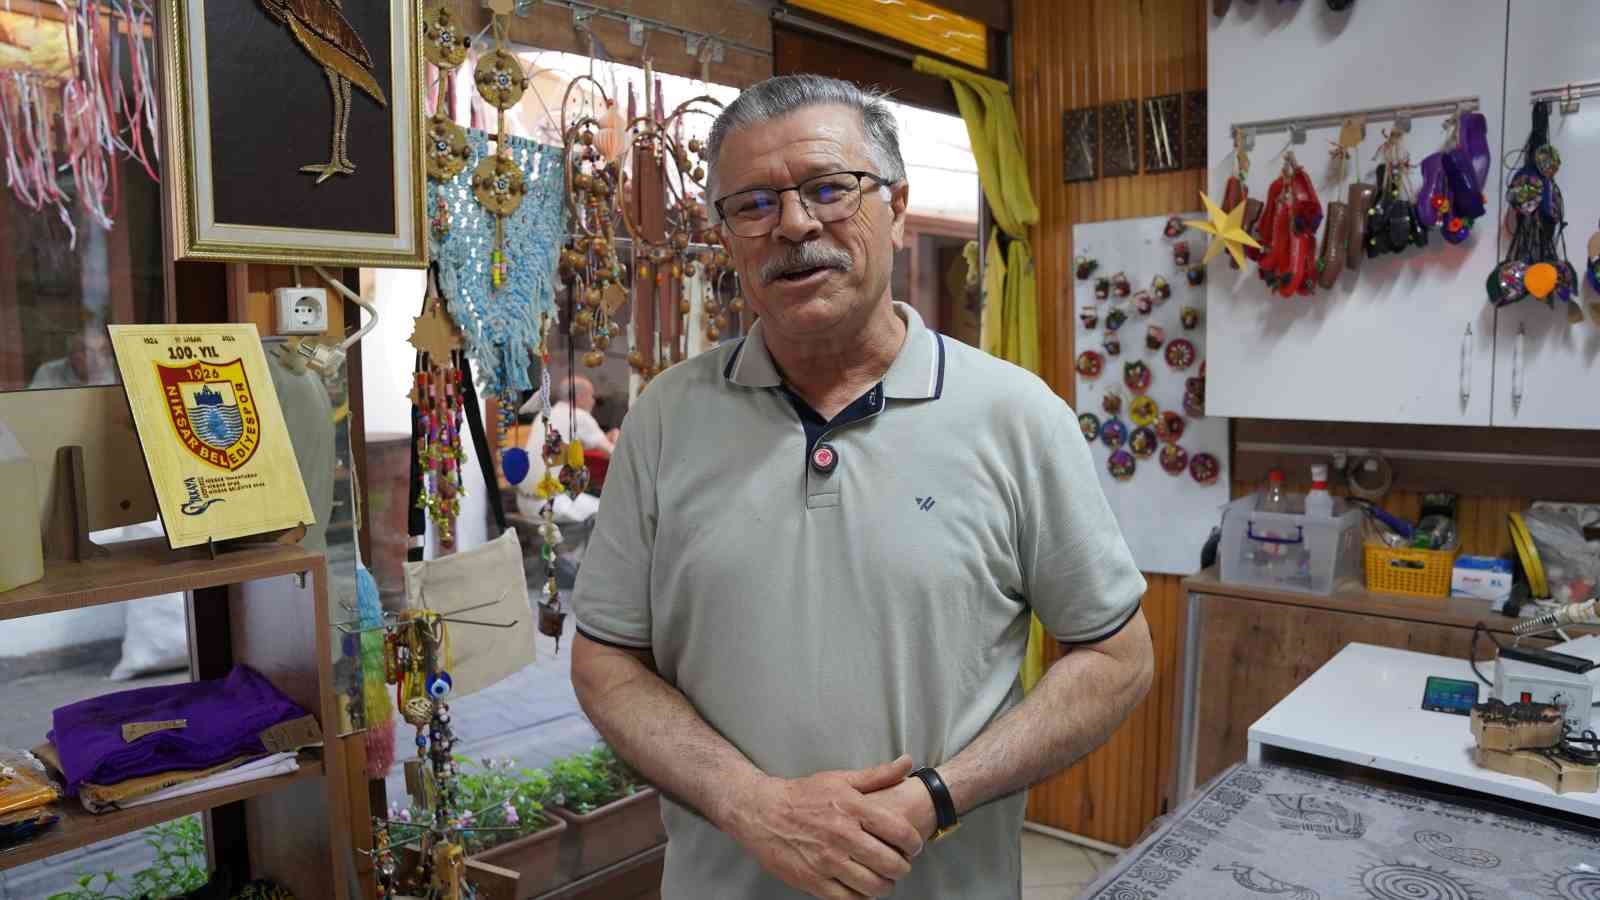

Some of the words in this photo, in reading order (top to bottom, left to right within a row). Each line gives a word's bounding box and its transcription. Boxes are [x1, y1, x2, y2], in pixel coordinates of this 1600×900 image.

[167, 346, 197, 360] 100.
[198, 345, 219, 358] YIL
[187, 368, 220, 380] 1926
